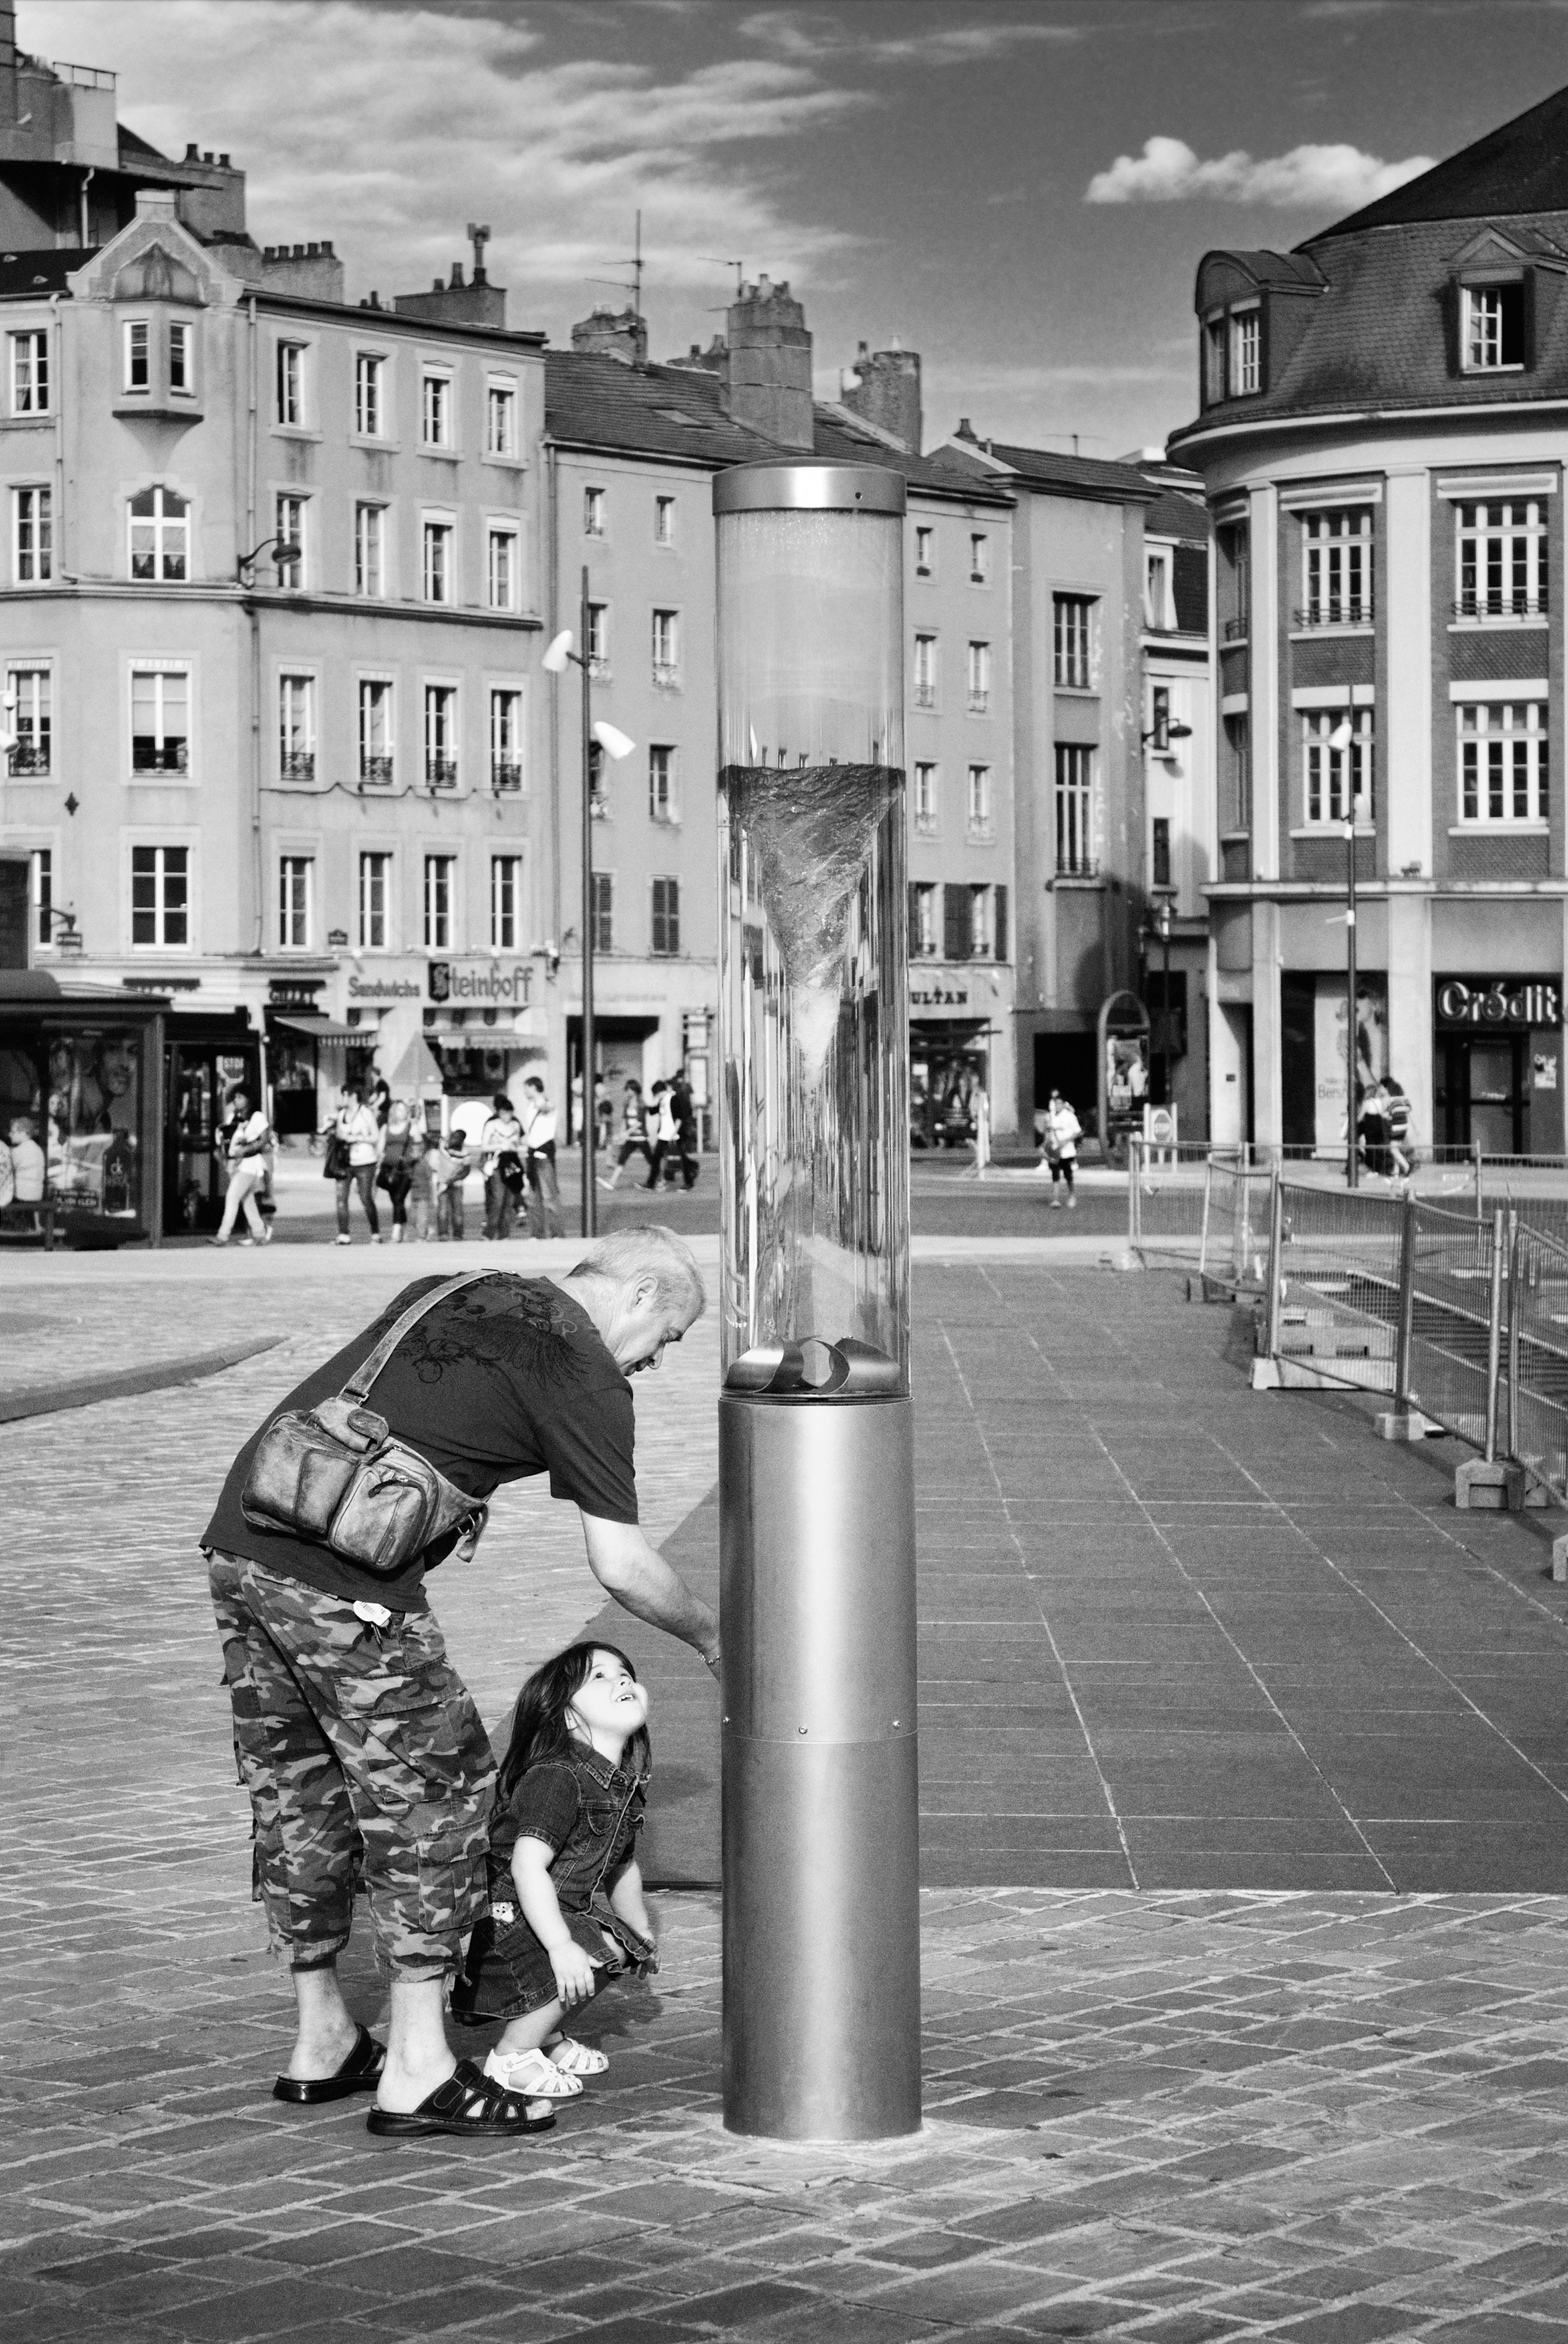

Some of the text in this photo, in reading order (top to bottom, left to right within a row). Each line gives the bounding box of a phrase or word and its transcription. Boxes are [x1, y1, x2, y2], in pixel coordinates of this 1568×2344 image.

[431, 963, 533, 1002] Steinhoff
[909, 989, 968, 1004] ULTAN
[1438, 981, 1557, 1022] Crédit
